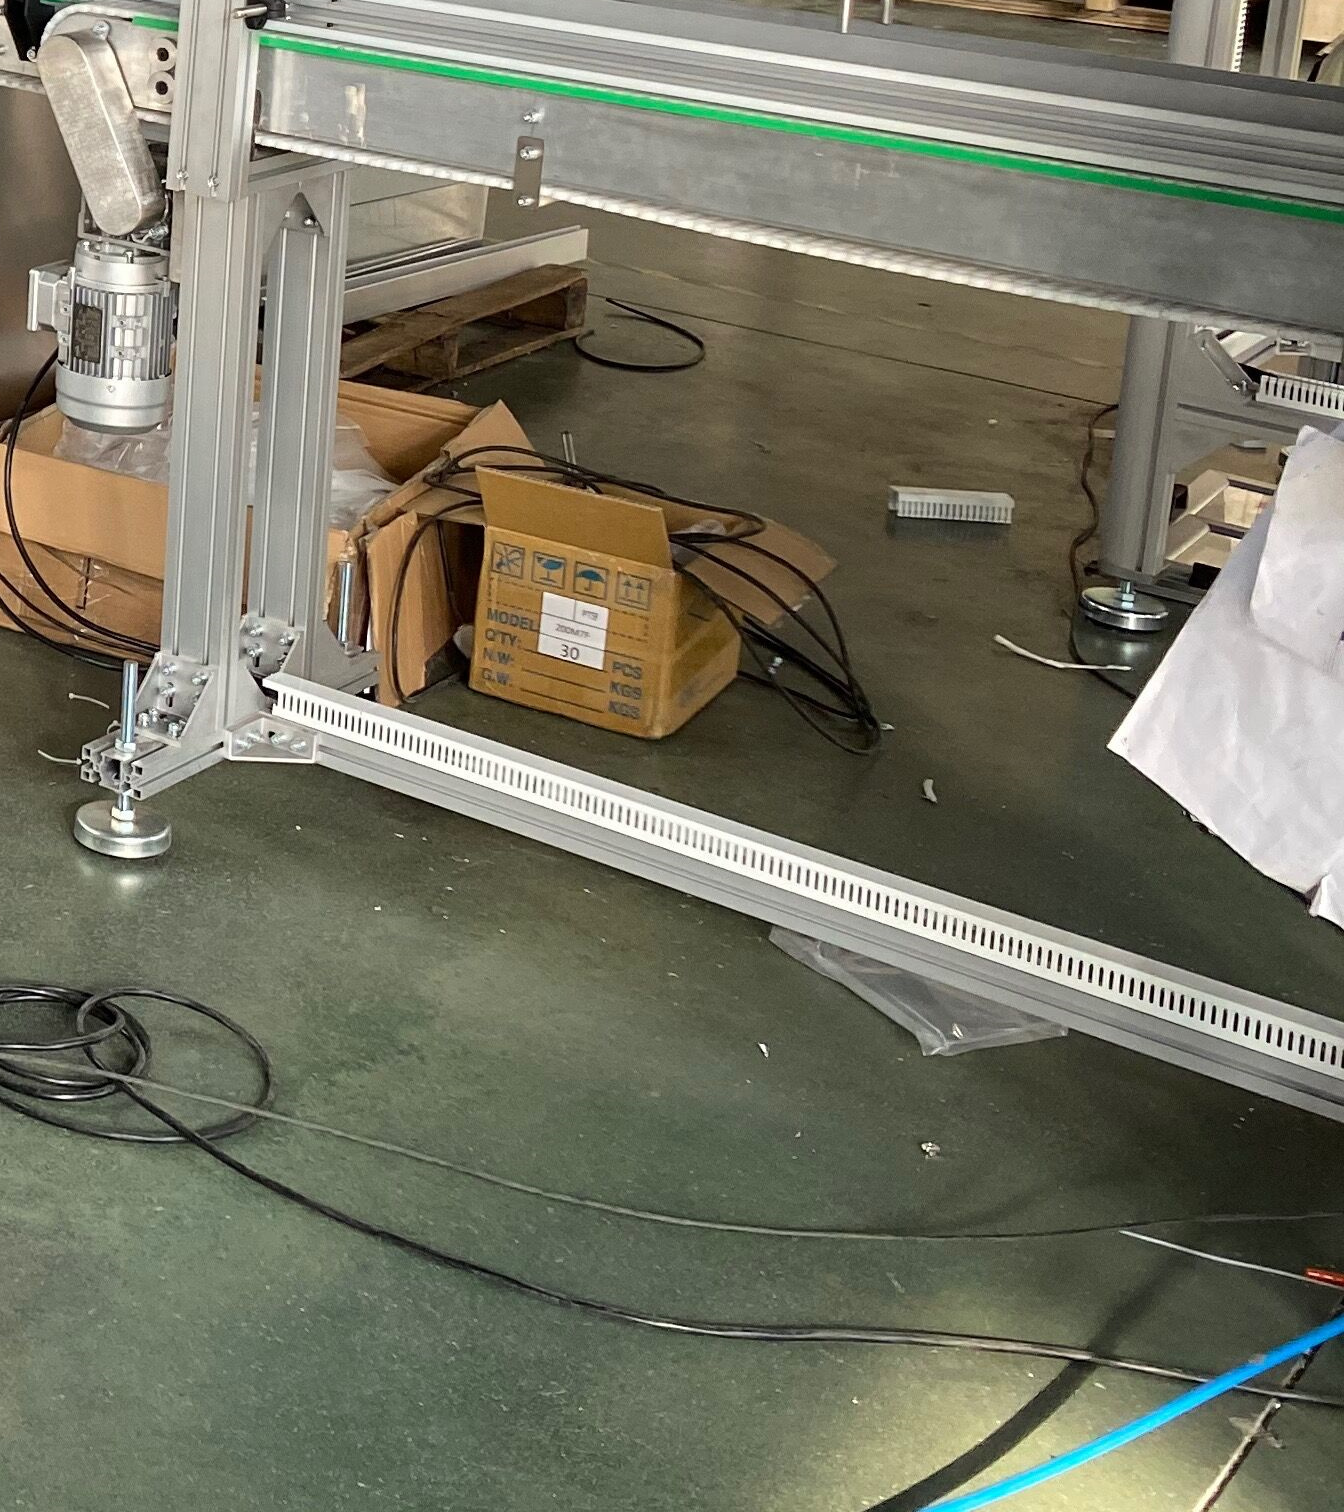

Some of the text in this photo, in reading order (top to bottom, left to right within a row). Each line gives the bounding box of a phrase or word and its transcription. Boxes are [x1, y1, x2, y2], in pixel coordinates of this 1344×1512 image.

[560, 644, 580, 660] 30
[612, 661, 642, 680] PCS
[610, 681, 642, 700] KGS
[608, 700, 641, 719] KGS
